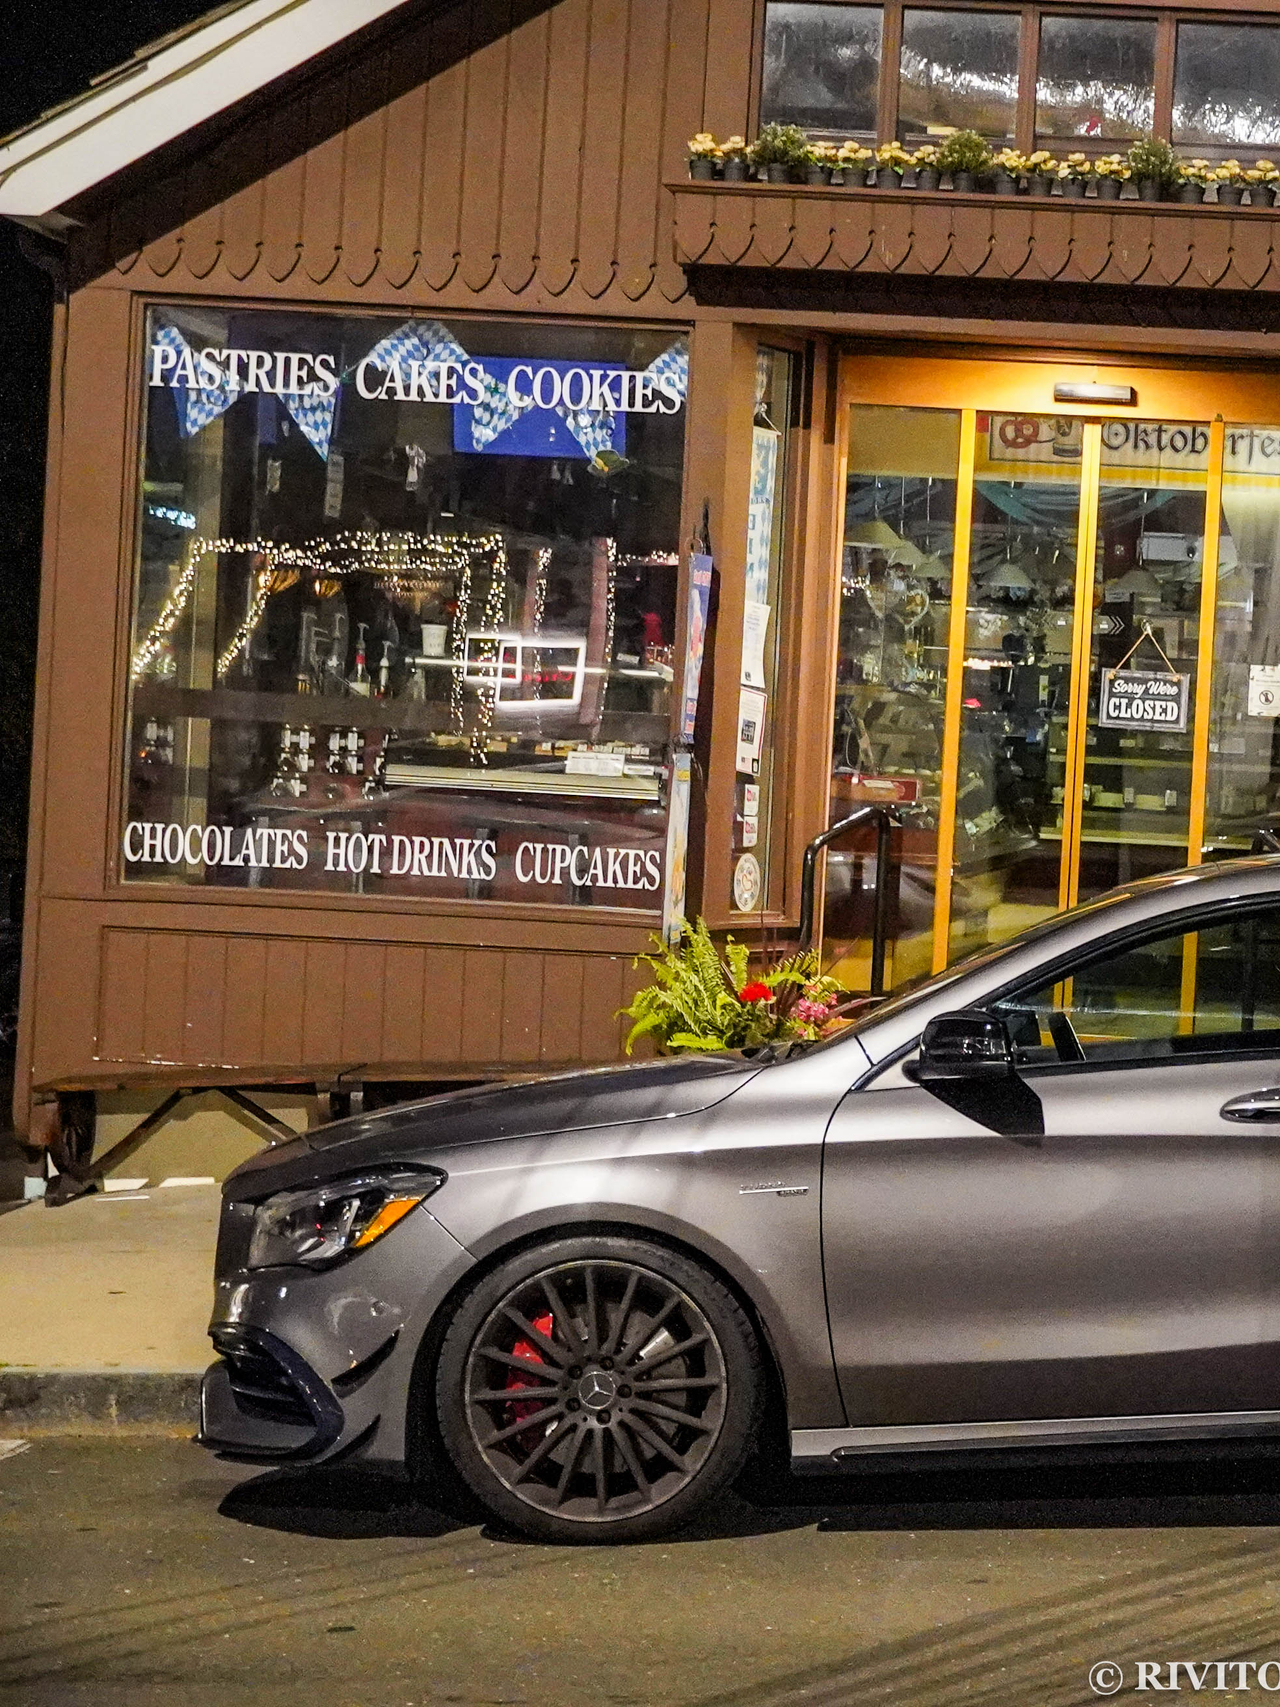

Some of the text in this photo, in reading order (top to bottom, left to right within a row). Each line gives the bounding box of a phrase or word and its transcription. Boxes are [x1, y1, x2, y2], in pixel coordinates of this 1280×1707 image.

[149, 344, 684, 415] PASTRIES CAKES COOKIES
[1108, 697, 1179, 721] CLOSED
[1112, 679, 1146, 698] Sorry
[123, 821, 661, 891] CHOCOLATES HOT DRINKS CUPCAKES
